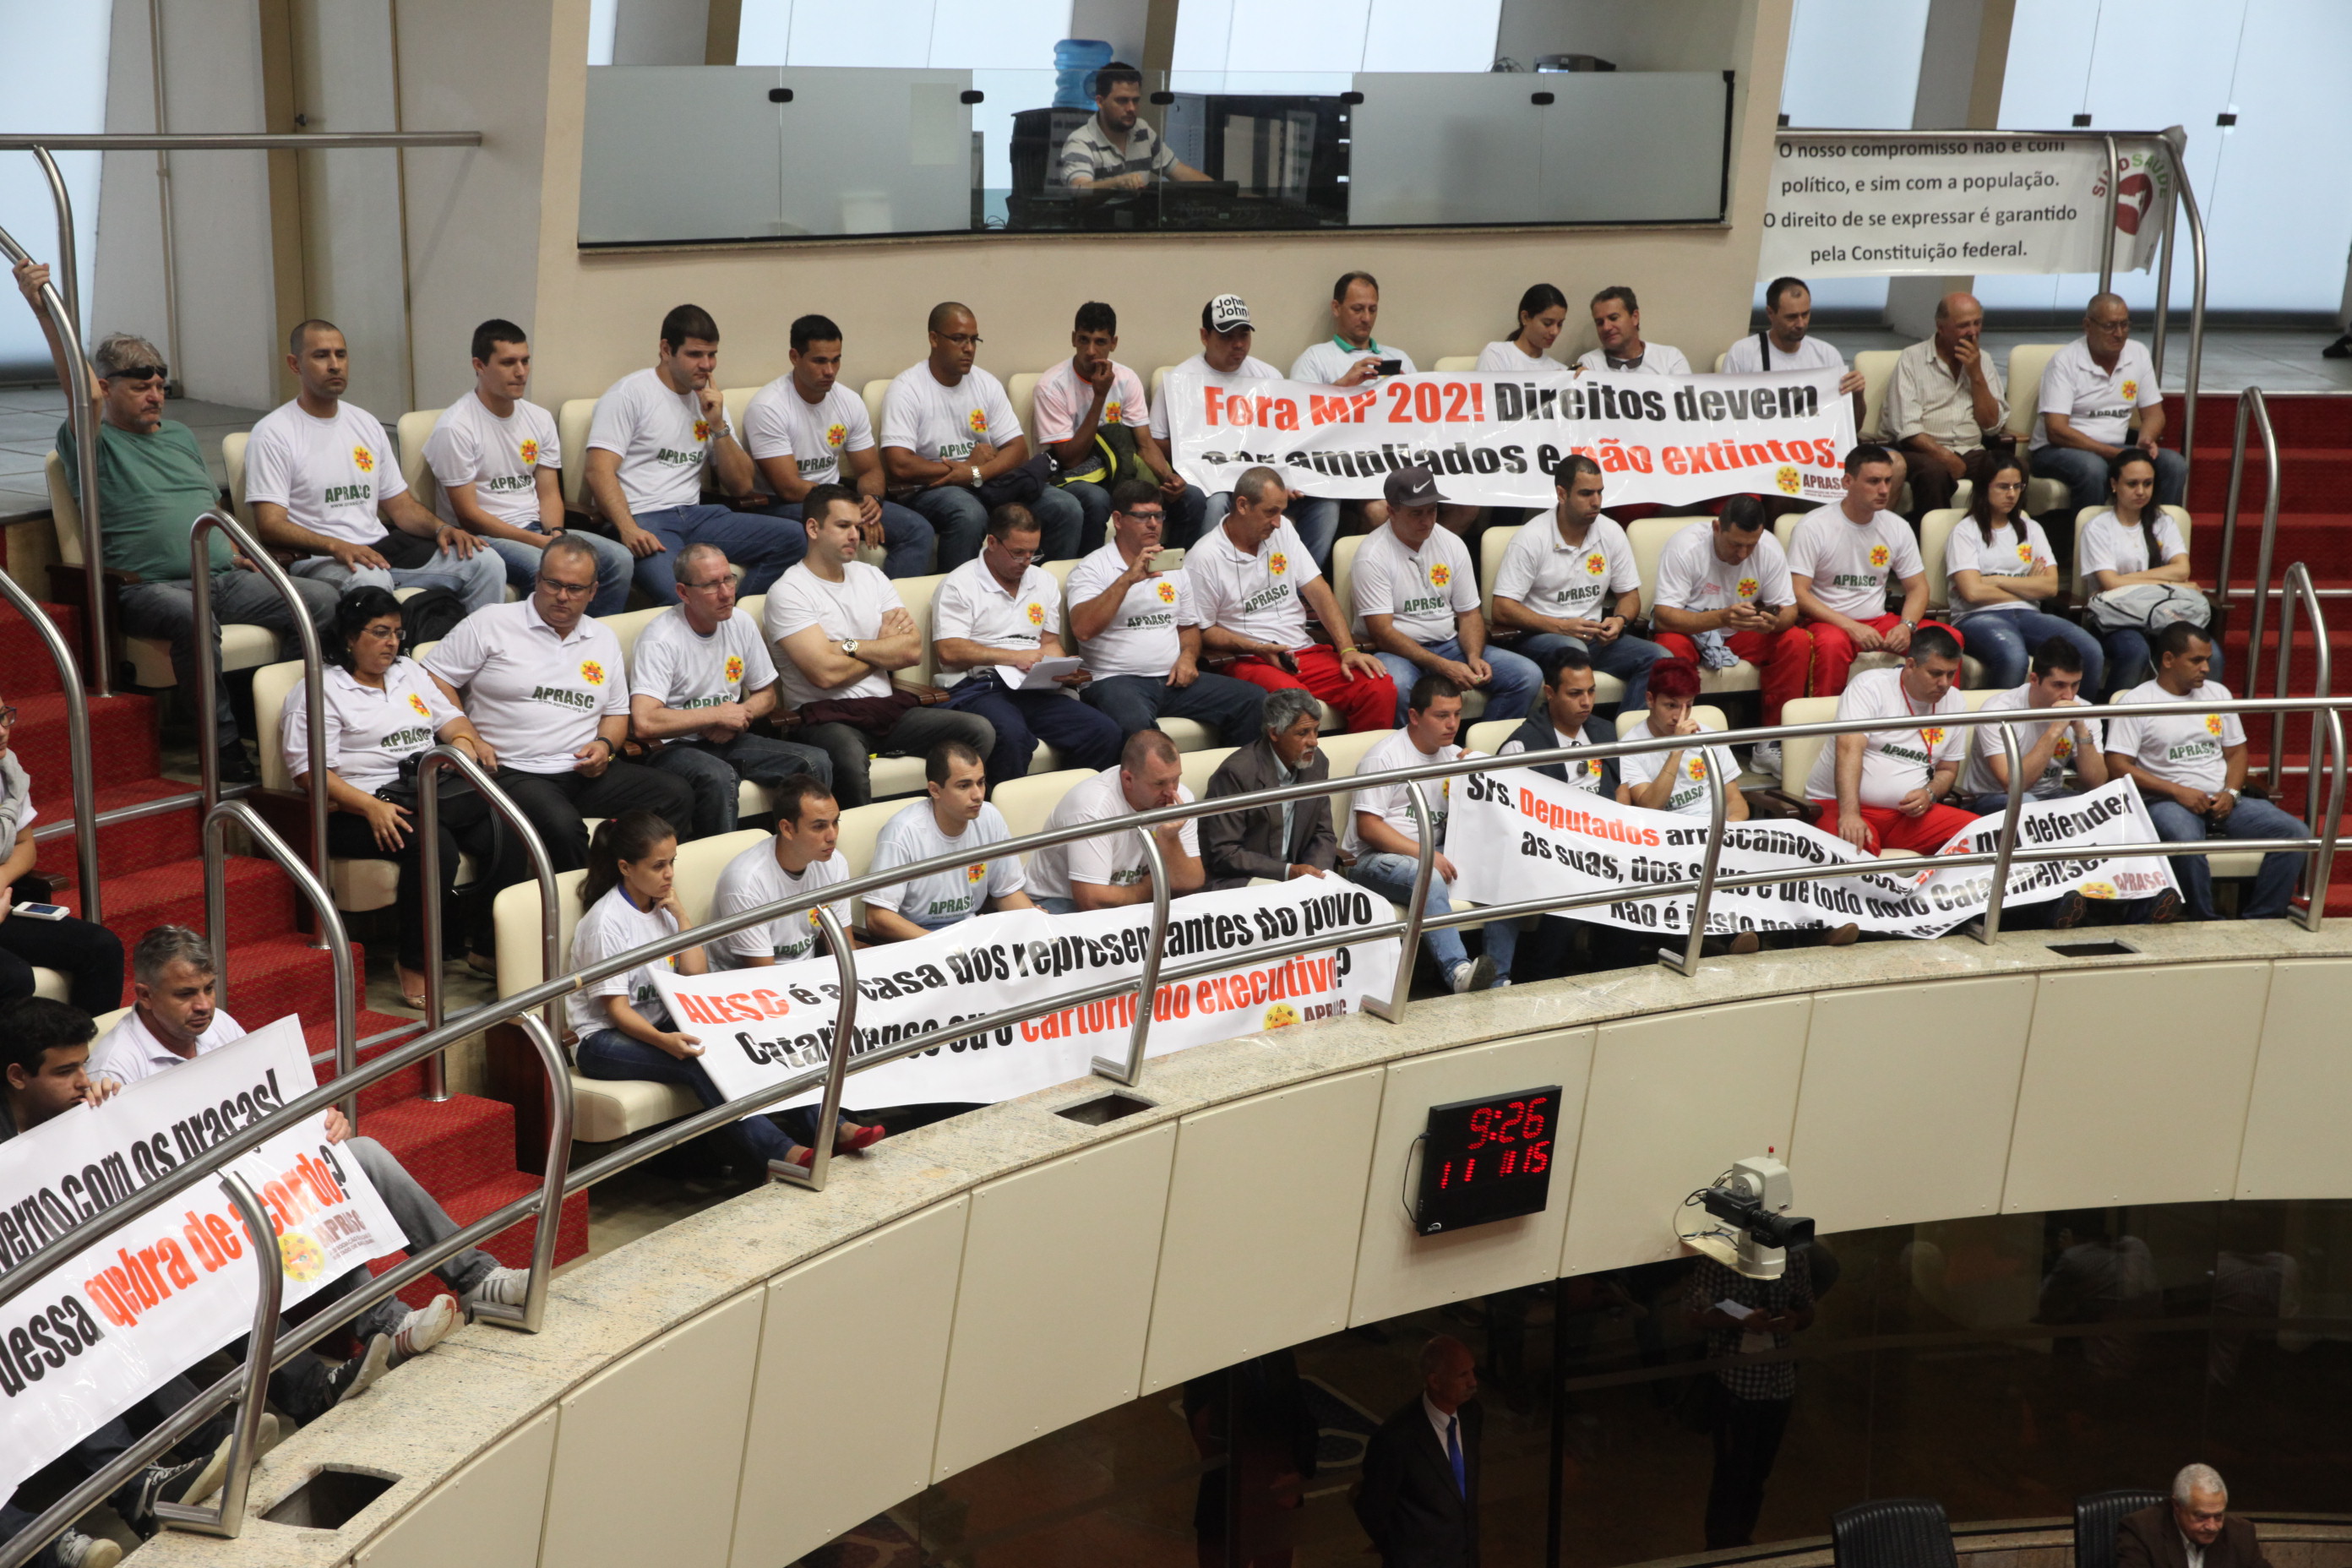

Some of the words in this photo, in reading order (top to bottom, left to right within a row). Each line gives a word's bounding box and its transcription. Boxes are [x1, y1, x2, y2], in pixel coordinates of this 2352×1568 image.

[1779, 142, 1792, 158] O
[1798, 144, 1846, 158] nosso
[1852, 141, 1968, 160] compromisso
[1782, 177, 1850, 196] político,
[1855, 180, 1865, 192] e
[1870, 176, 1900, 192] sim
[1906, 177, 1942, 191] com
[1947, 177, 1957, 189] a
[1963, 171, 2060, 193] população.
[1763, 212, 1776, 228] O
[1781, 211, 1837, 227] direito
[1842, 210, 1864, 226] de
[1869, 214, 1886, 226] se
[1892, 210, 1975, 228] expressar
[1980, 206, 1990, 223] é
[1995, 204, 2077, 226] garantido
[1810, 245, 1846, 265] pela
[1852, 242, 1957, 263] Constituição
[1963, 240, 2028, 258] federal.
[1204, 385, 1300, 431] Fora
[1309, 389, 1377, 427] MP
[1386, 382, 1485, 423] 202!
[1494, 381, 1666, 422] Direitos
[1674, 383, 1820, 422] devem
[1662, 437, 1846, 475] extintos.
[1832, 574, 1877, 587] APRASC
[1245, 584, 1289, 613] APRASC
[1127, 613, 1172, 628] APRASC
[531, 685, 596, 710] APRASC
[380, 727, 433, 749] APRASC
[1467, 772, 1516, 809] Srs.
[1520, 787, 1660, 847] Deputados
[2024, 792, 2134, 844] defender
[1522, 830, 1553, 860] as
[1558, 844, 1625, 884] suas,
[1631, 856, 1682, 883] dos
[1813, 880, 1864, 916] todo
[1865, 896, 1930, 919] povo
[1663, 900, 1680, 930] é
[673, 988, 791, 1025] ALESC
[788, 983, 822, 1005] é
[857, 964, 949, 1002] casa
[945, 943, 1010, 985] dos
[1254, 906, 1298, 942] do
[1300, 891, 1373, 937] povo
[1196, 946, 1352, 1015] executivo?
[1467, 1097, 1548, 1150] 9:26
[61, 1152, 138, 1222] com
[131, 1131, 178, 1184] os
[84, 1238, 199, 1328] quebra
[182, 1210, 243, 1273] de
